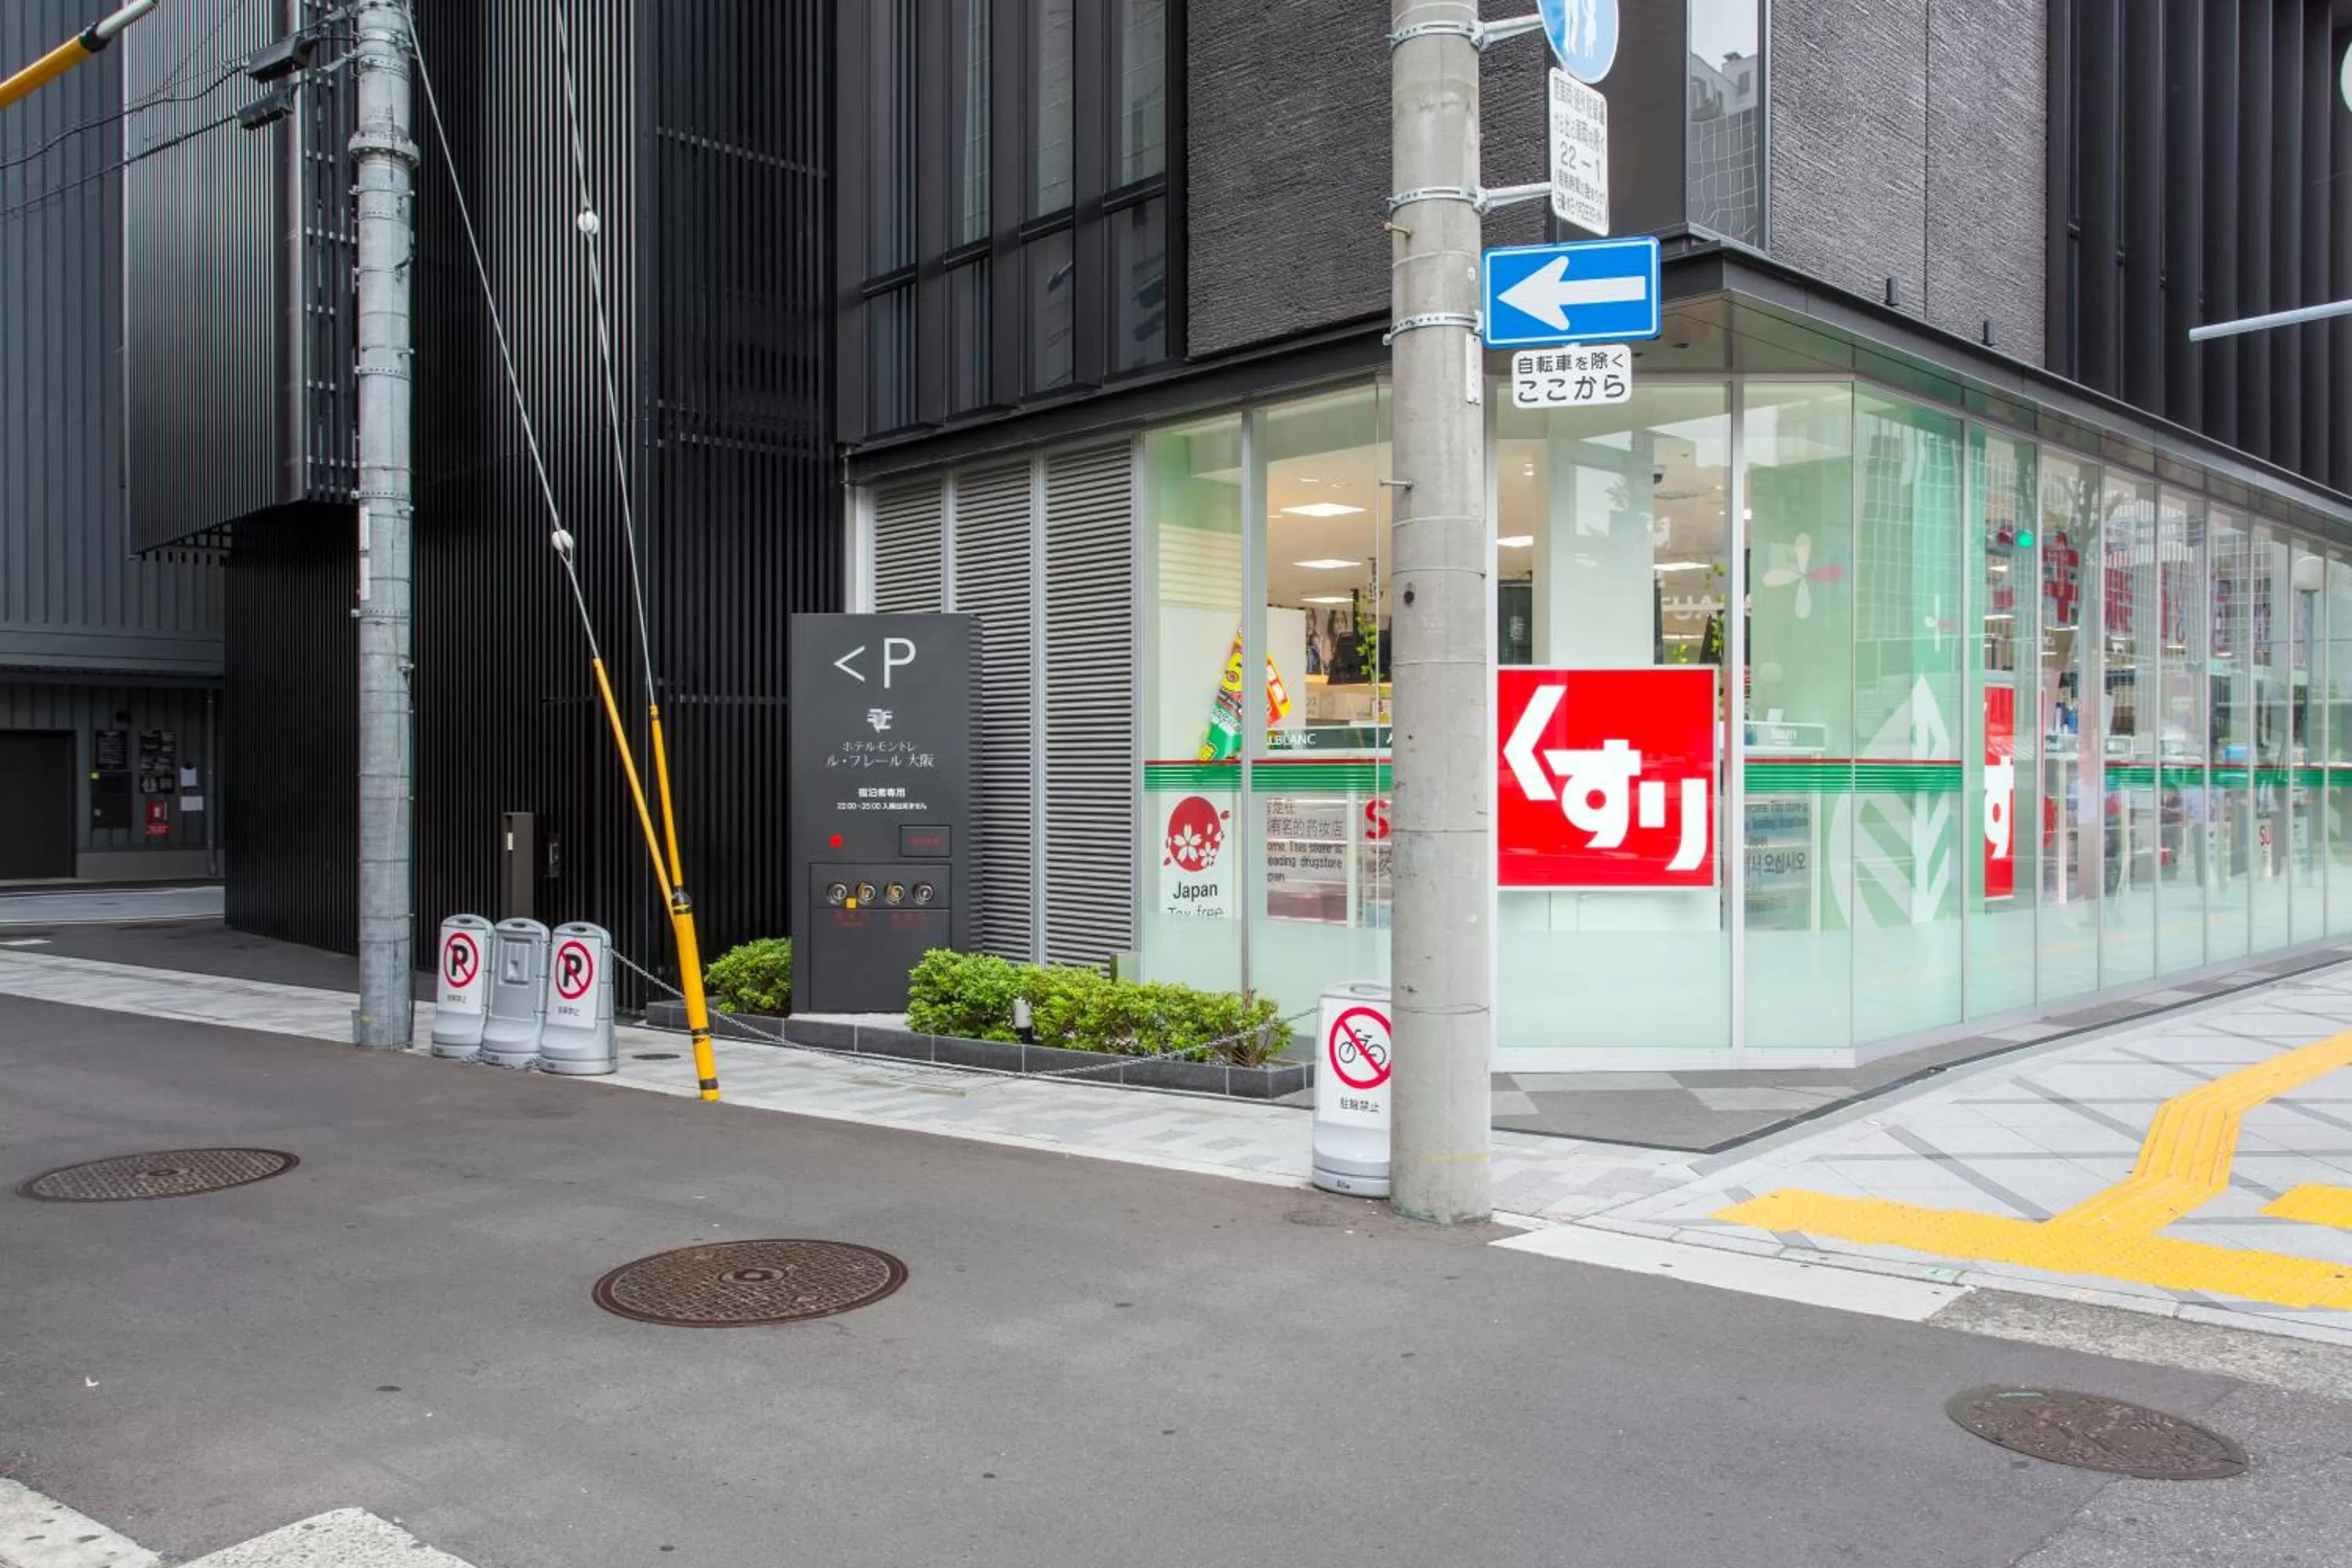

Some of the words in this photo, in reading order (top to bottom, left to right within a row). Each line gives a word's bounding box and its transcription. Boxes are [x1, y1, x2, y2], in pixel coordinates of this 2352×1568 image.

[1518, 351, 1624, 374] 自転車を除く
[1518, 374, 1625, 402] ここから
[884, 637, 916, 688] P
[842, 741, 916, 752] ホテルモントレ
[909, 753, 935, 768] 大阪
[1503, 684, 1708, 871] くすり
[1267, 856, 1296, 868] eading
[1173, 881, 1218, 902] Japan
